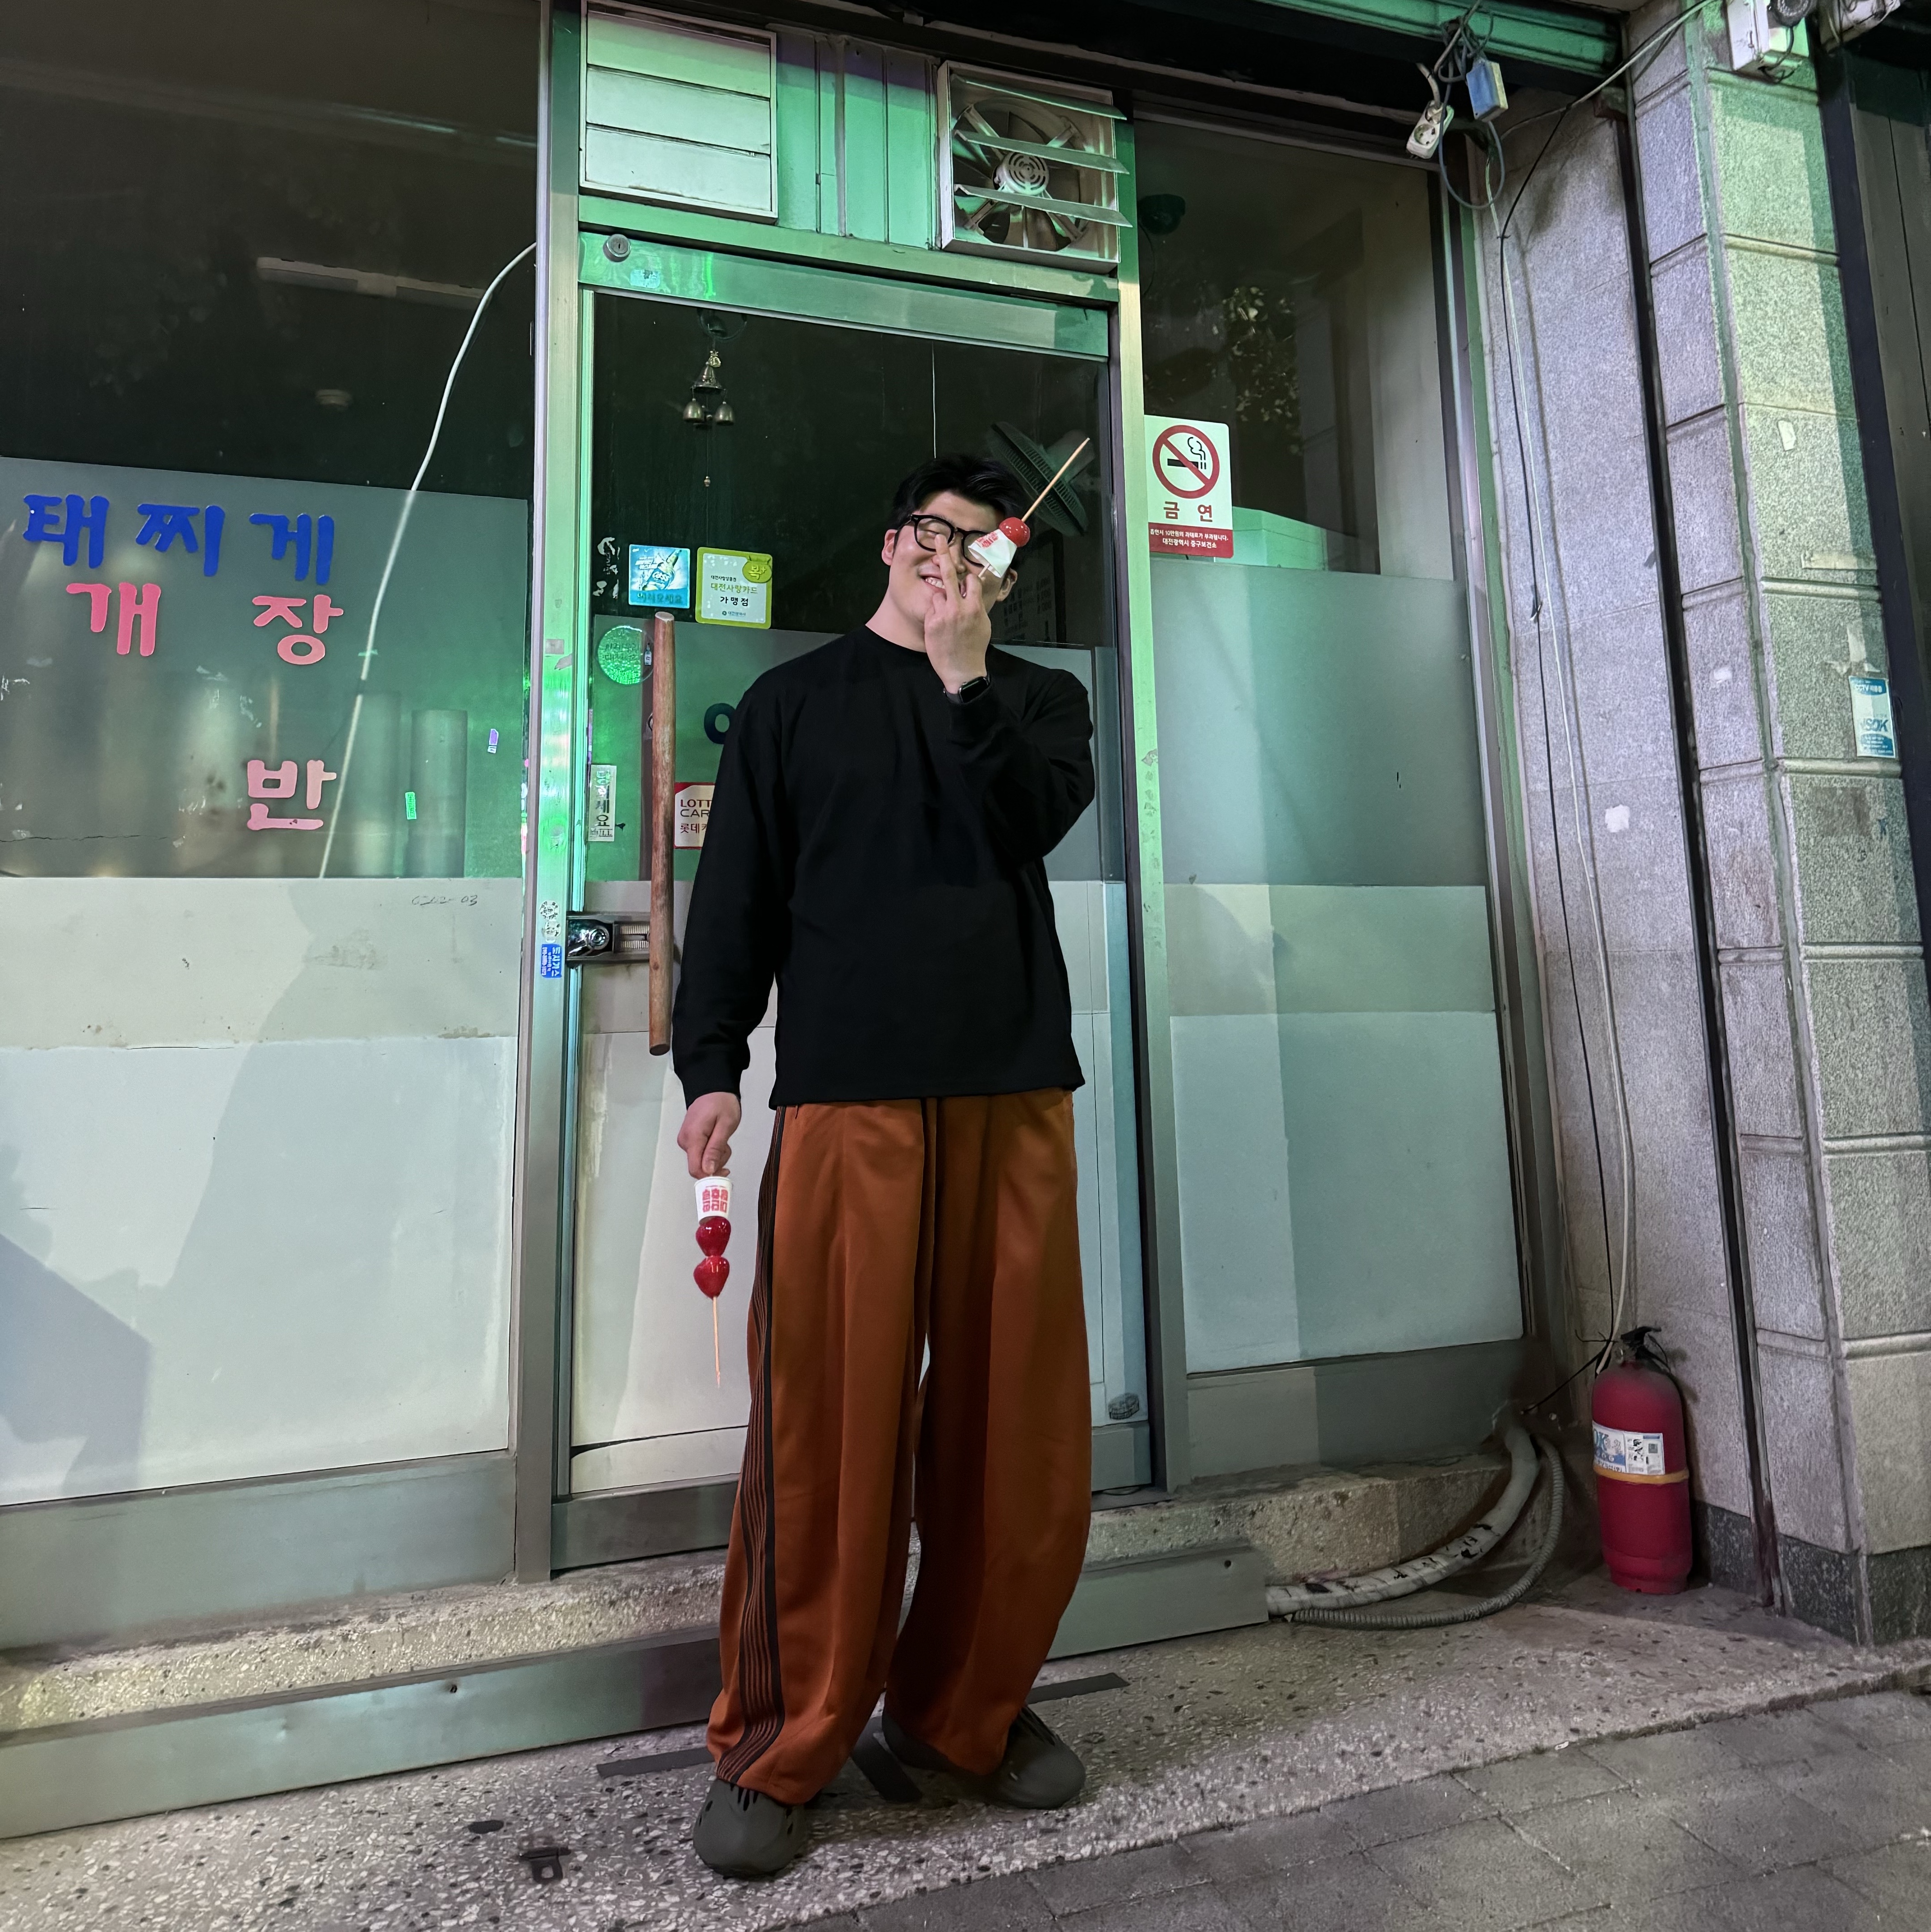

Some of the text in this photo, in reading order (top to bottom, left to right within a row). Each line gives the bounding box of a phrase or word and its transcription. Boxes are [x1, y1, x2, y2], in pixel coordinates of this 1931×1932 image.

[1162, 537, 1217, 549] 대전광역시 중구보건소
[711, 583, 758, 594] 대전사랑카드
[247, 759, 337, 831] 반
